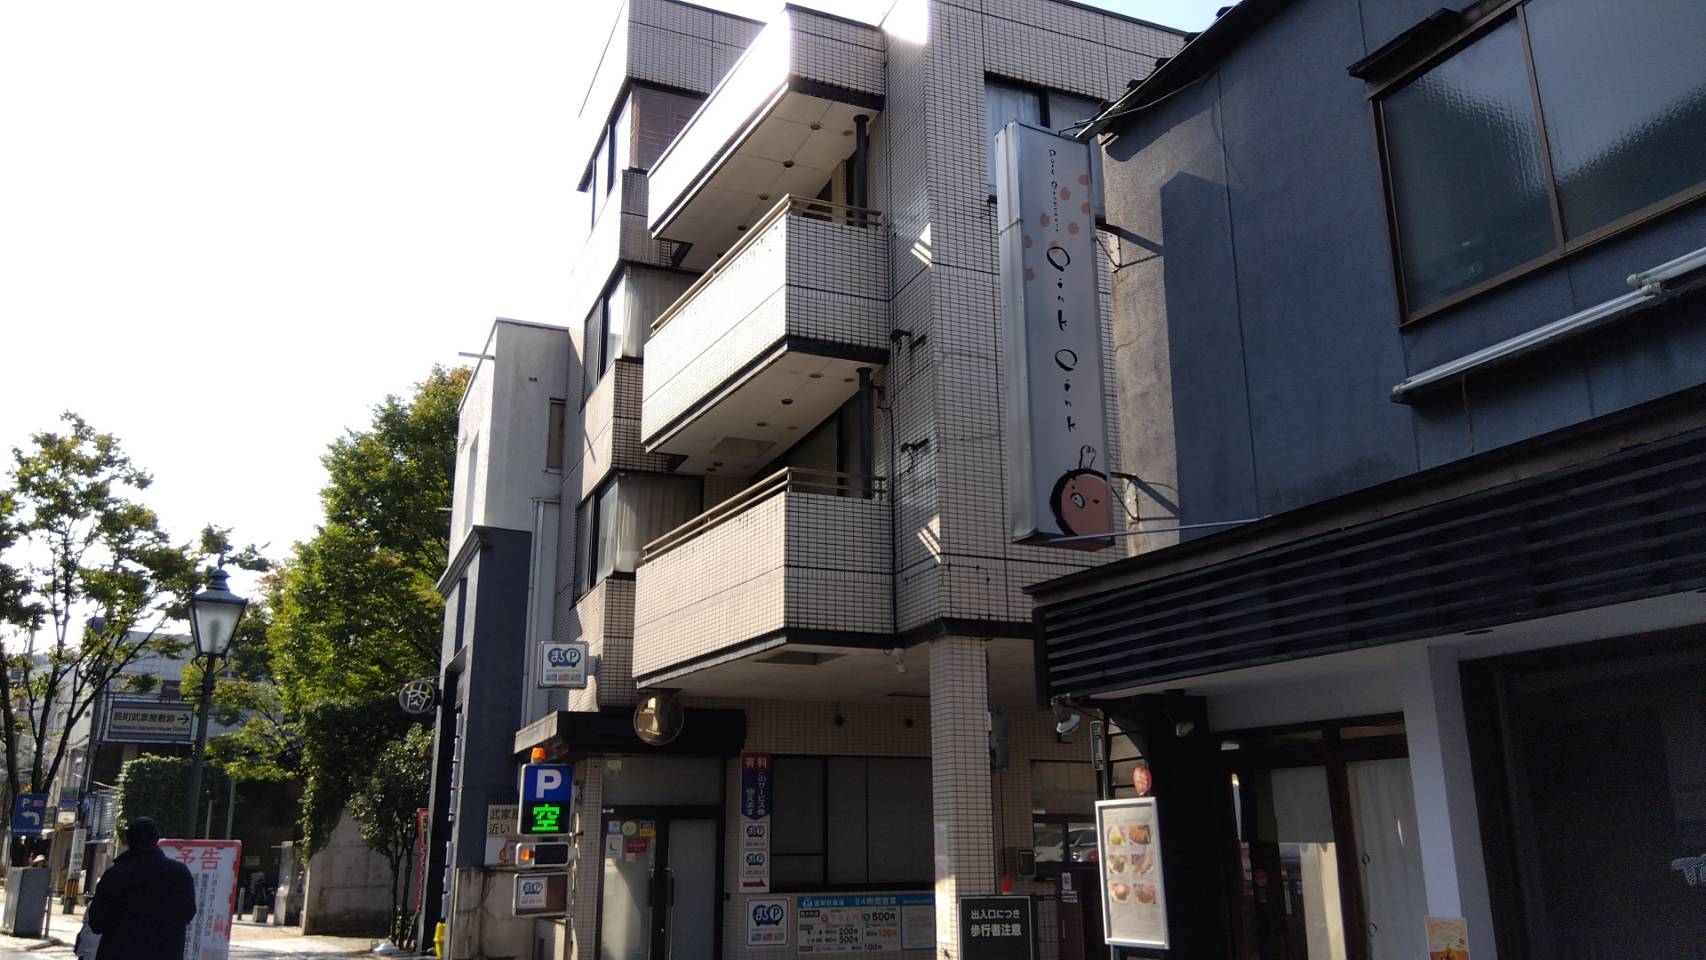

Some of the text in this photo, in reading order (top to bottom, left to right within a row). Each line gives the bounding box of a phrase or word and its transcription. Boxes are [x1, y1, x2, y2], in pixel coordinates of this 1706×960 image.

[1046, 246, 1077, 433] Oink Oink
[535, 769, 562, 799] P
[22, 798, 30, 808] P
[531, 803, 560, 832] 空
[175, 848, 221, 870] 予告
[970, 908, 1020, 920] 出入口につき
[970, 922, 1022, 938] 歩行者注意
